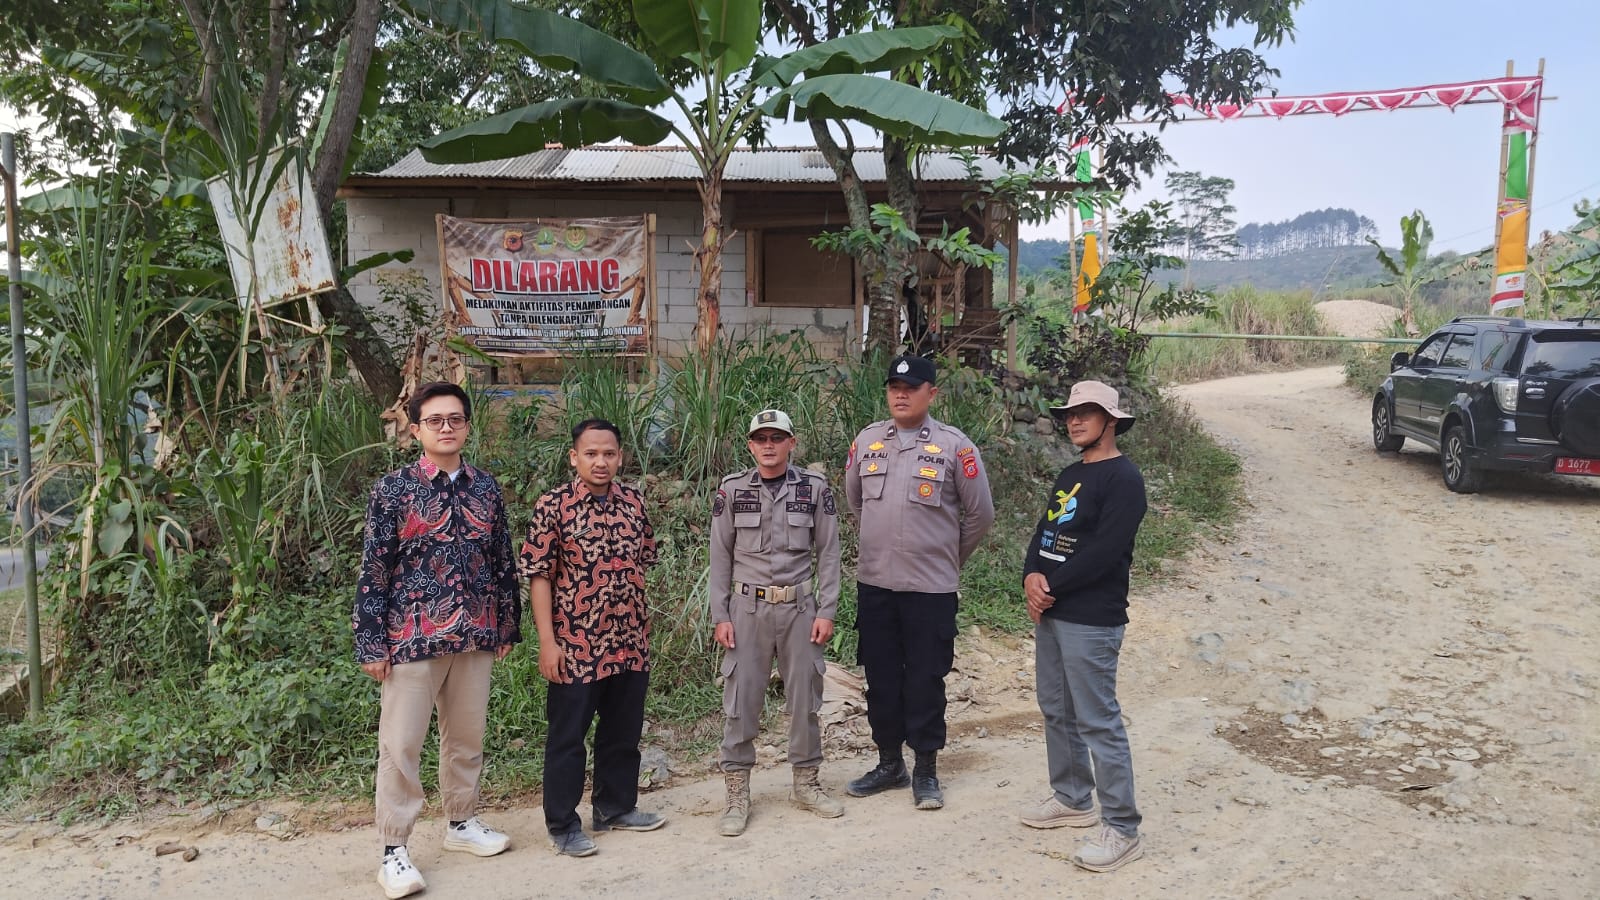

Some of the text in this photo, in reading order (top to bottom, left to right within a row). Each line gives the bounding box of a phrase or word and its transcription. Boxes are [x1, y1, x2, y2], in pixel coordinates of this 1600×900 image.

[472, 258, 621, 293] DILARANG
[465, 299, 631, 311] MELAKUKAN AKTIFITAS PENAMBANGAN
[500, 313, 527, 324] TANPA
[528, 314, 580, 325] DILENGKAPI
[484, 327, 511, 337] PIDANA
[512, 327, 543, 337] PENJARA
[917, 455, 945, 465] POLRI
[1557, 458, 1591, 469] D 1677
